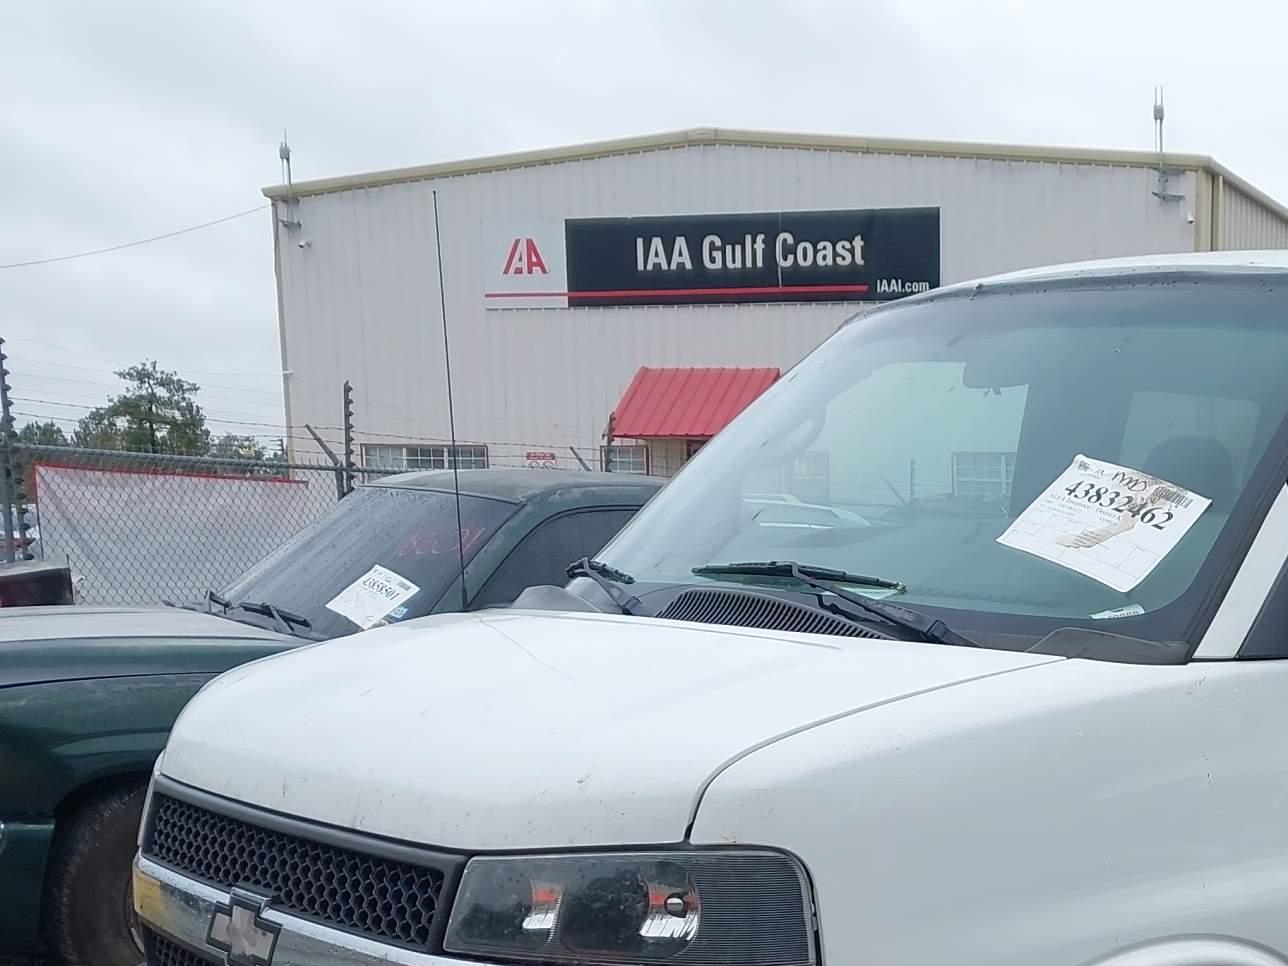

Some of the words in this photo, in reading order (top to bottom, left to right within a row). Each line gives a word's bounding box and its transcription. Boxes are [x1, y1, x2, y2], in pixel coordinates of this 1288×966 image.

[636, 236, 693, 271] IAA
[702, 234, 766, 269] Gulf
[775, 232, 865, 267] Coast
[876, 278, 930, 294] IAAI.com
[1064, 480, 1174, 530] 43832462
